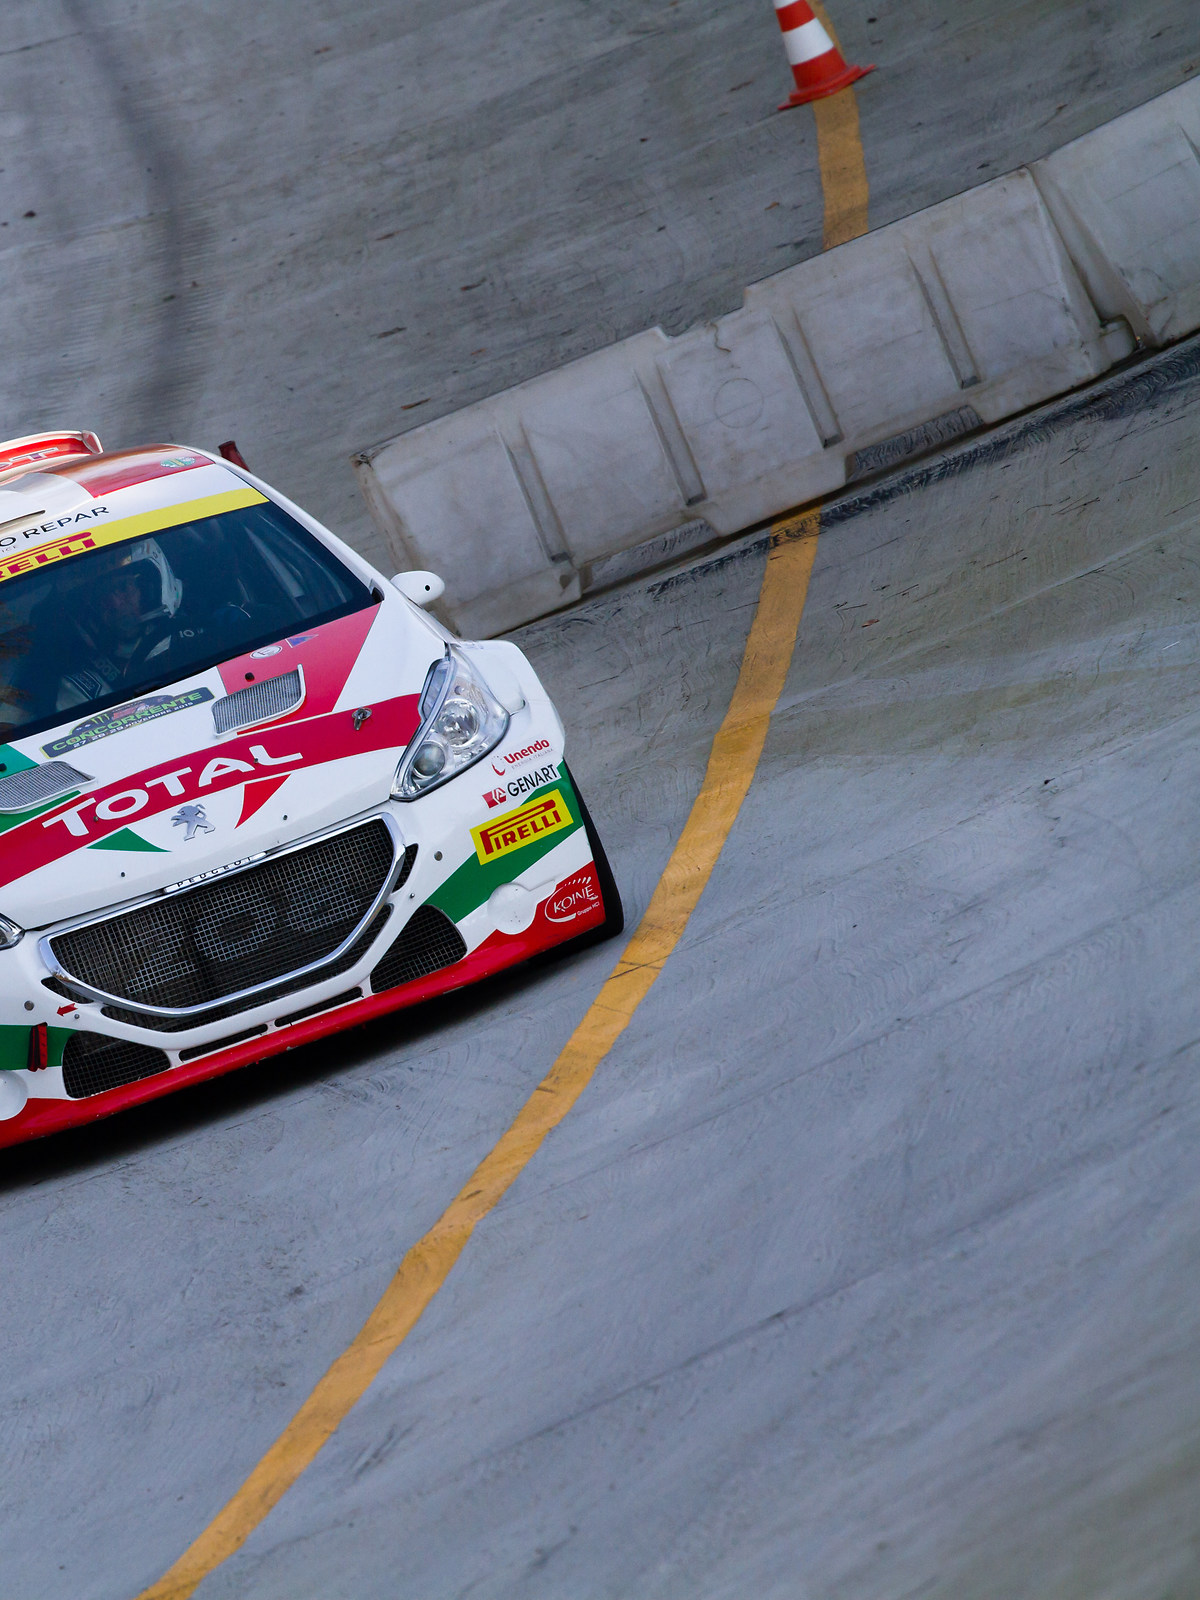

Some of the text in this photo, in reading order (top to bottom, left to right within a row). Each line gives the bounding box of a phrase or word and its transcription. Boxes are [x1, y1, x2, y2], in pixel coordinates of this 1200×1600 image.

[22, 505, 110, 539] REPAR
[52, 692, 203, 751] CONCORRENTE
[73, 740, 87, 749] 27
[125, 708, 172, 728] NOVEMBRE
[173, 702, 194, 711] 2015
[503, 739, 550, 764] Unendo
[42, 744, 304, 837] TOTAL
[507, 764, 558, 797] GENART
[479, 799, 562, 855] PIRELLI
[554, 885, 595, 914] KOINE
